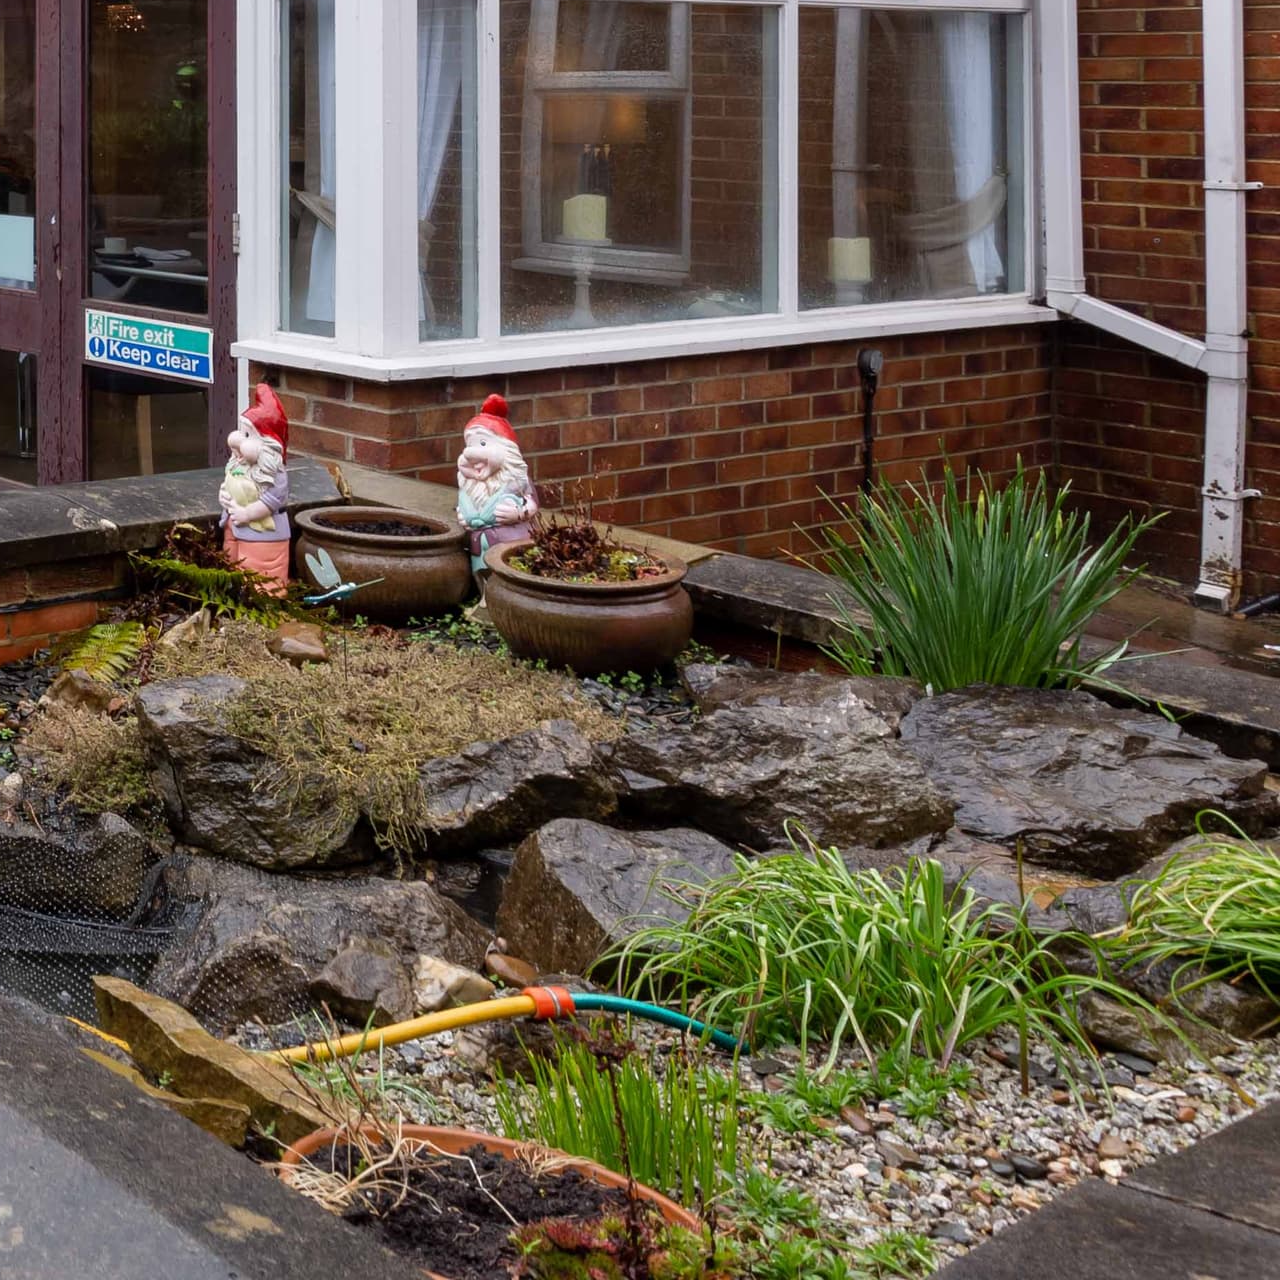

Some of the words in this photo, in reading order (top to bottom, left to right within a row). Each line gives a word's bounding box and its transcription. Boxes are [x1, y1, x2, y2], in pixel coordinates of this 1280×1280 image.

[109, 319, 139, 340] Fire
[143, 328, 174, 346] exit
[109, 340, 151, 365] Keep
[156, 350, 199, 372] clear
